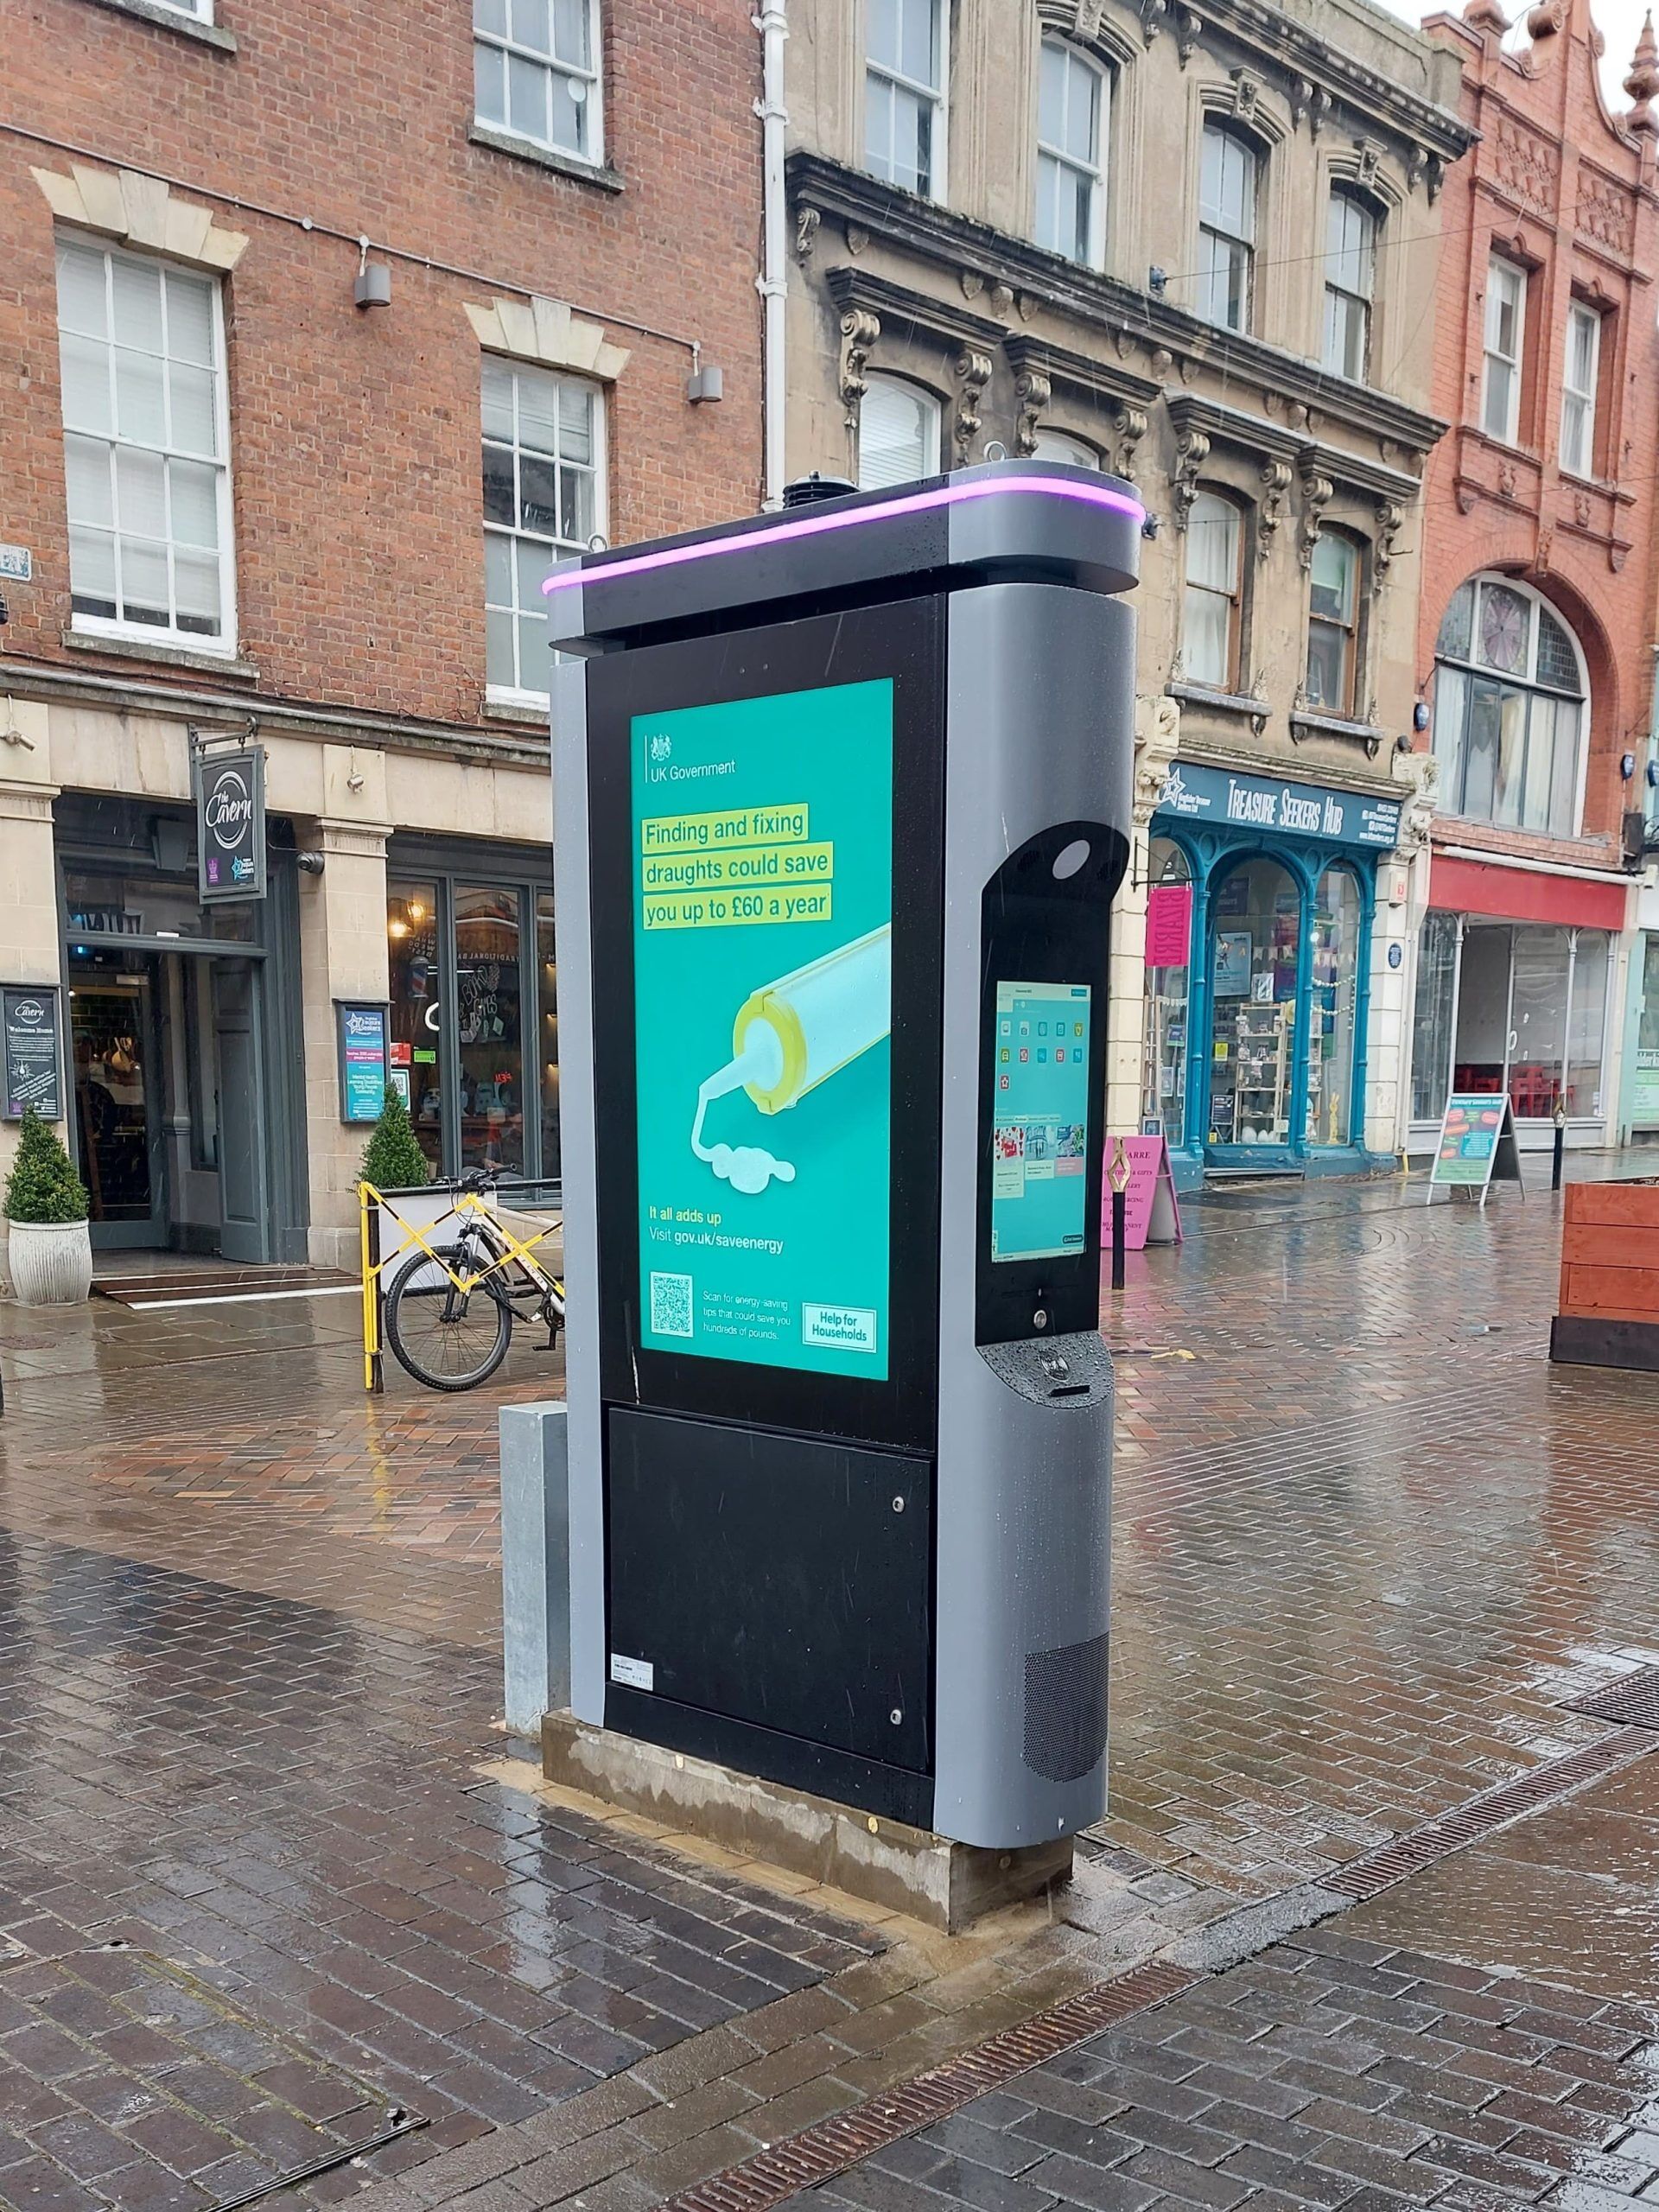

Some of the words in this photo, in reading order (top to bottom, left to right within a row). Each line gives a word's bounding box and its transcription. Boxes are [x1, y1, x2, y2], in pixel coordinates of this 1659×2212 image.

[651, 767, 667, 783] UK
[670, 760, 736, 780] Government
[206, 791, 252, 827] Cavern
[646, 820, 709, 845] Finding
[715, 815, 747, 838] and
[753, 811, 803, 836] fixing
[646, 860, 722, 886] draughts
[728, 853, 778, 877] could
[785, 853, 829, 873] save
[647, 905, 677, 927] you
[683, 905, 703, 923] up
[709, 900, 726, 918] to
[732, 896, 763, 917] £60
[769, 900, 779, 916] a
[785, 896, 827, 919] year
[649, 1205, 659, 1219] It
[660, 1206, 673, 1220] all
[676, 1207, 703, 1224] adds
[707, 1211, 721, 1227] up
[649, 1227, 672, 1242] Visit
[674, 1231, 784, 1255] gov.uk/saveenergy
[703, 1290, 721, 1301] Scan
[723, 1291, 733, 1301] for
[703, 1306, 717, 1318] tips
[718, 1307, 733, 1319] that
[734, 1309, 755, 1321] could
[756, 1313, 775, 1324] save
[777, 1315, 791, 1326] you
[820, 1311, 842, 1327] Help
[843, 1313, 856, 1326] for
[703, 1321, 738, 1336] hundreds
[740, 1325, 747, 1337] of
[748, 1327, 779, 1341] pounds.
[811, 1324, 867, 1342] Households
